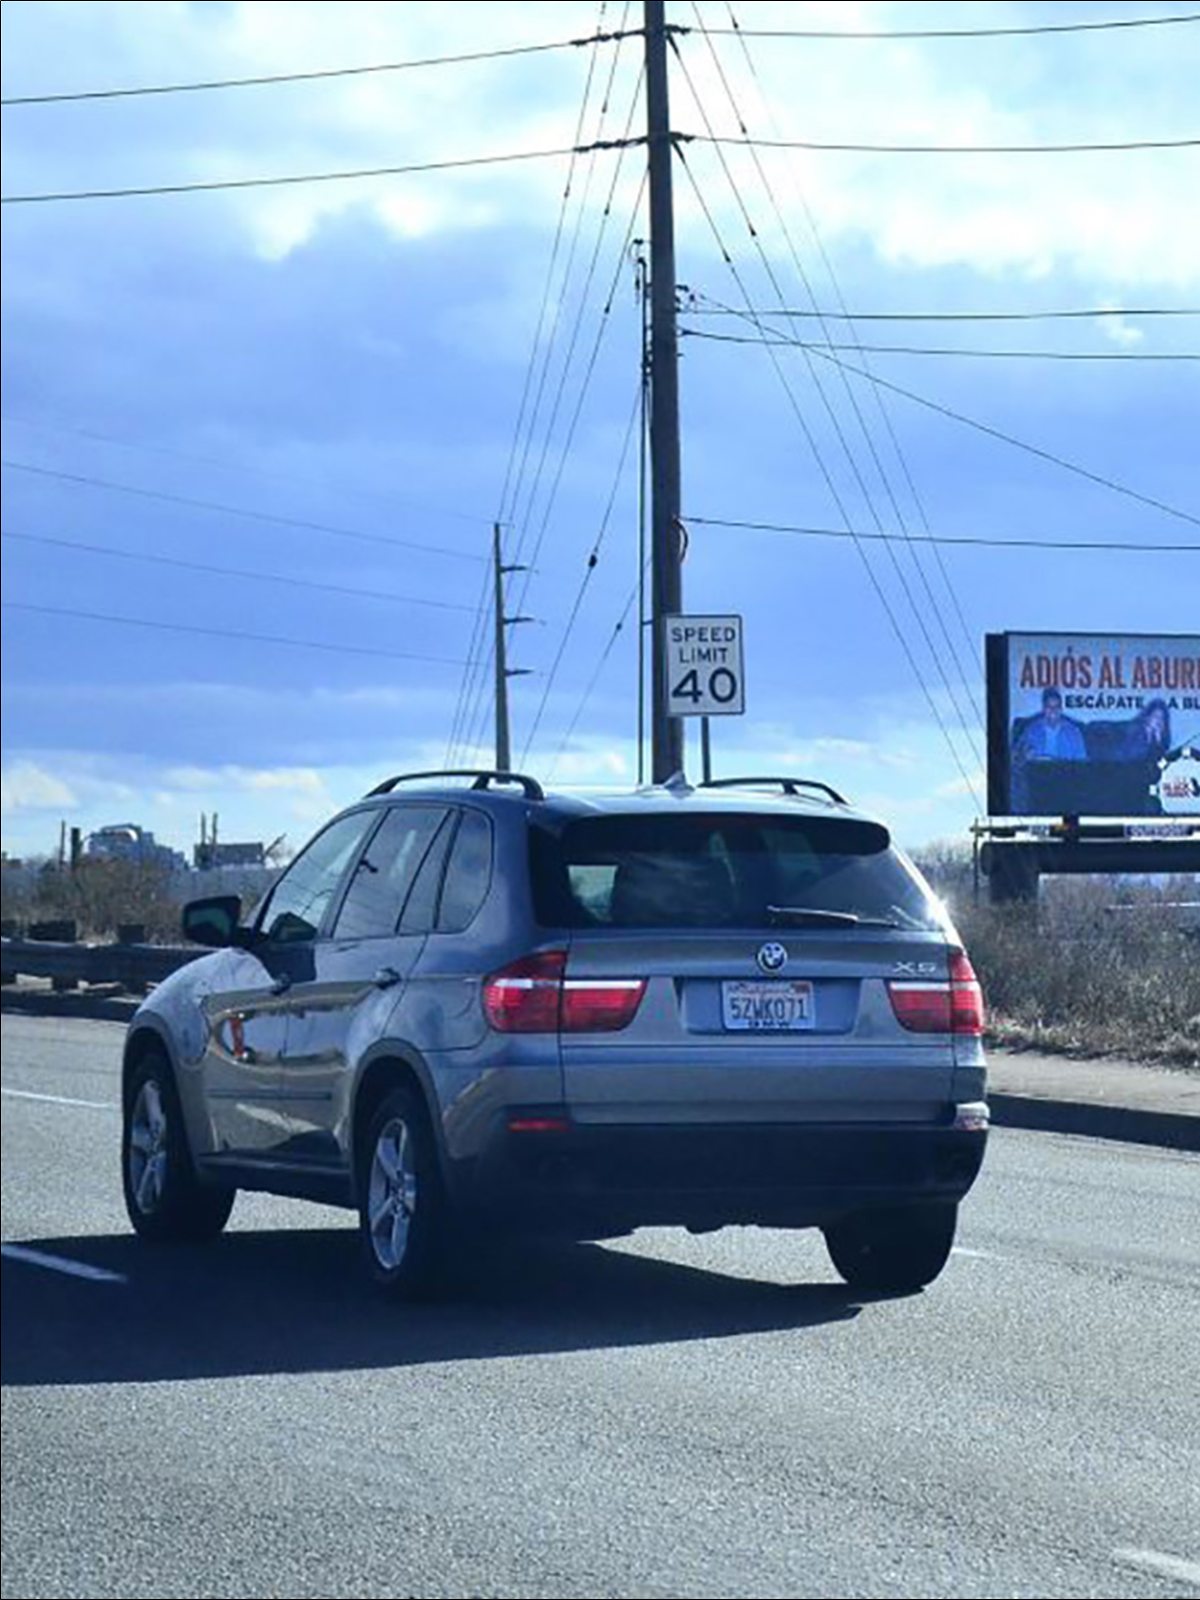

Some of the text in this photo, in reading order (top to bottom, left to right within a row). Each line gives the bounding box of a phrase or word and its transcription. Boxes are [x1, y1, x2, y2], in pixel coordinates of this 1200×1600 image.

[671, 626, 736, 642] SPEED
[679, 647, 728, 663] LIMIT
[1019, 646, 1092, 689] ADIÓS
[1098, 655, 1127, 689] AL
[671, 666, 737, 704] 40
[1065, 692, 1145, 709] ESCÁPATE
[1168, 697, 1179, 709] A
[893, 961, 937, 975] X5
